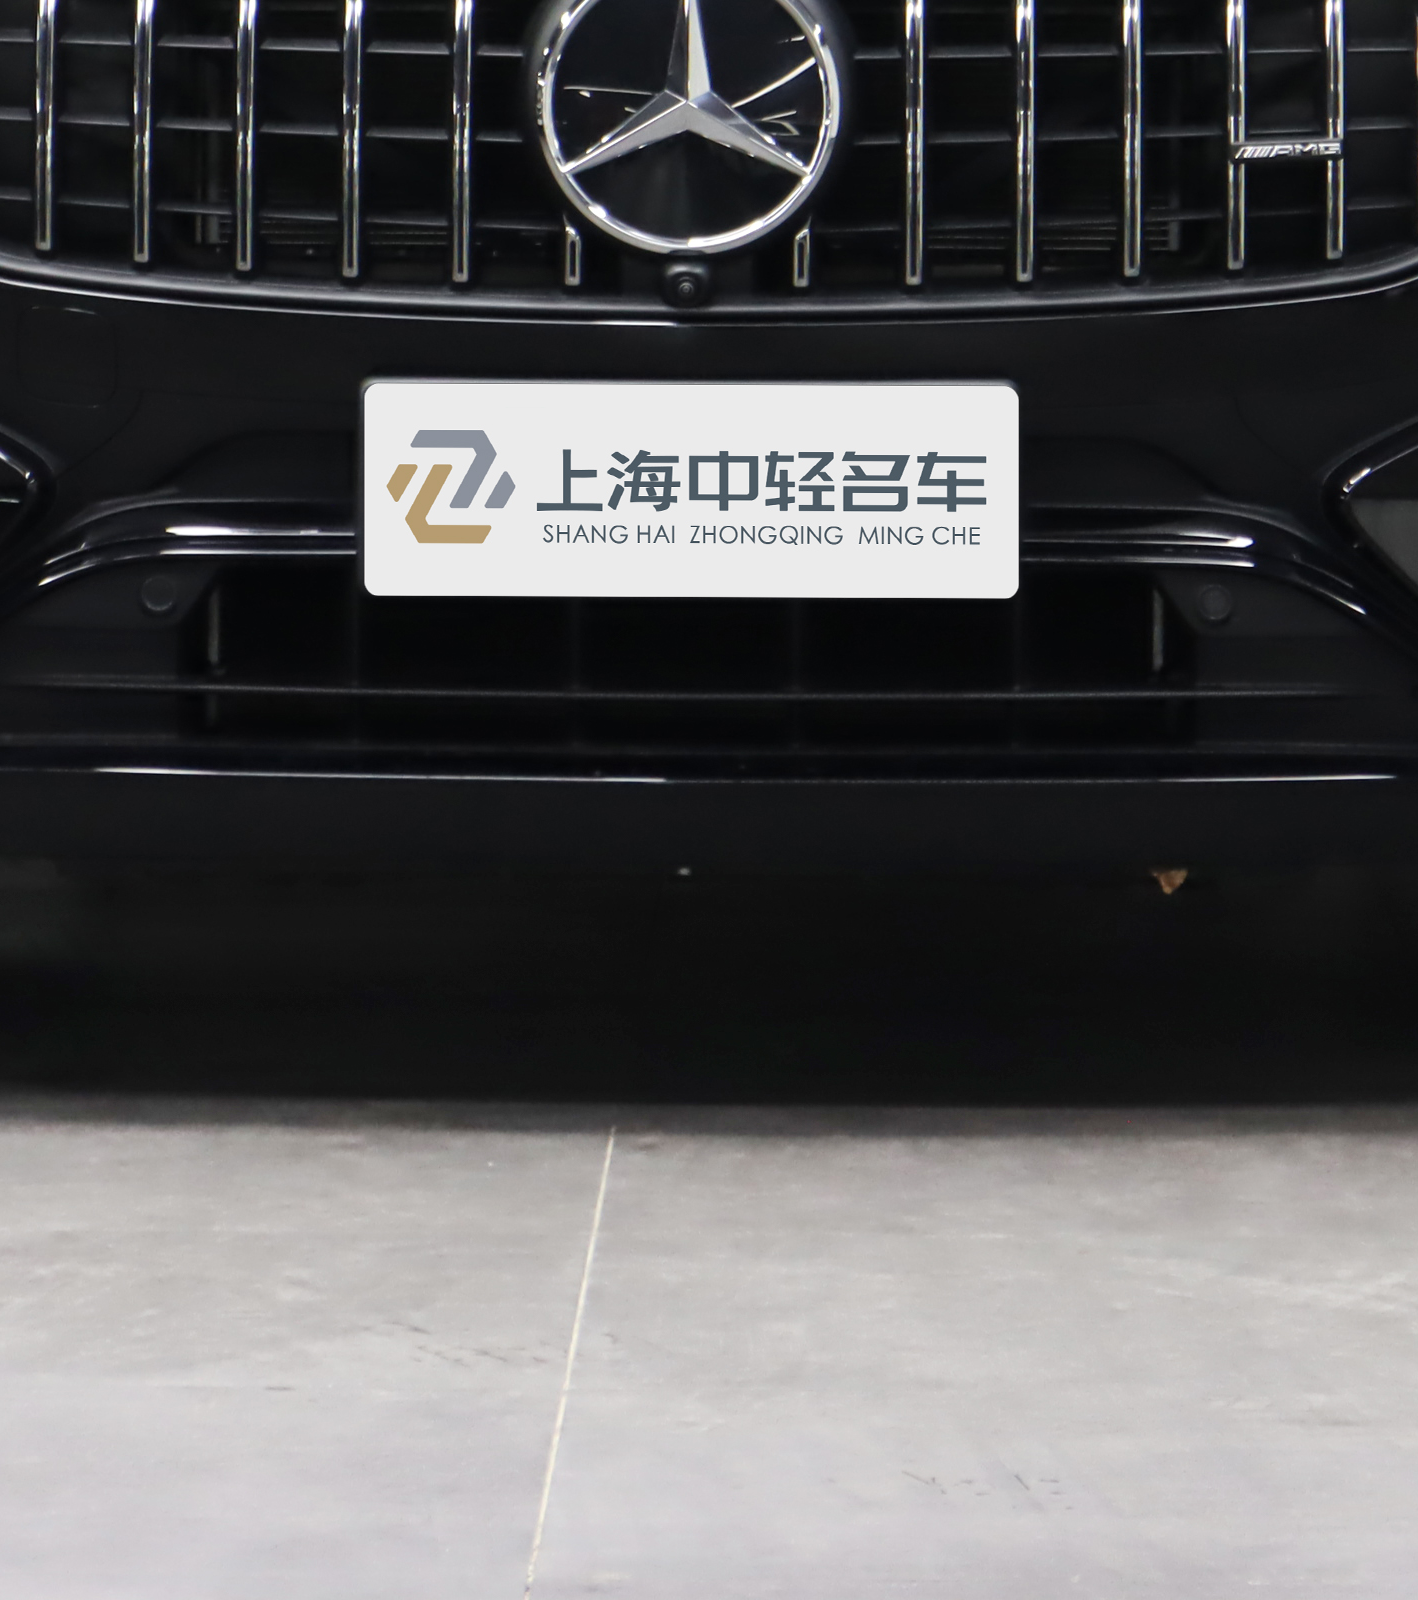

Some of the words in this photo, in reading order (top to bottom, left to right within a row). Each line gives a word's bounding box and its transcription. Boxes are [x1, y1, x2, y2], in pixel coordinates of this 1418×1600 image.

[1269, 142, 1342, 158] AMG
[536, 448, 987, 513] 上海中轻名车
[542, 523, 629, 545] SHANG
[637, 523, 675, 545] HAI
[689, 523, 844, 547] ZHONGQING
[858, 525, 924, 547] MING
[931, 525, 981, 546] CHE
